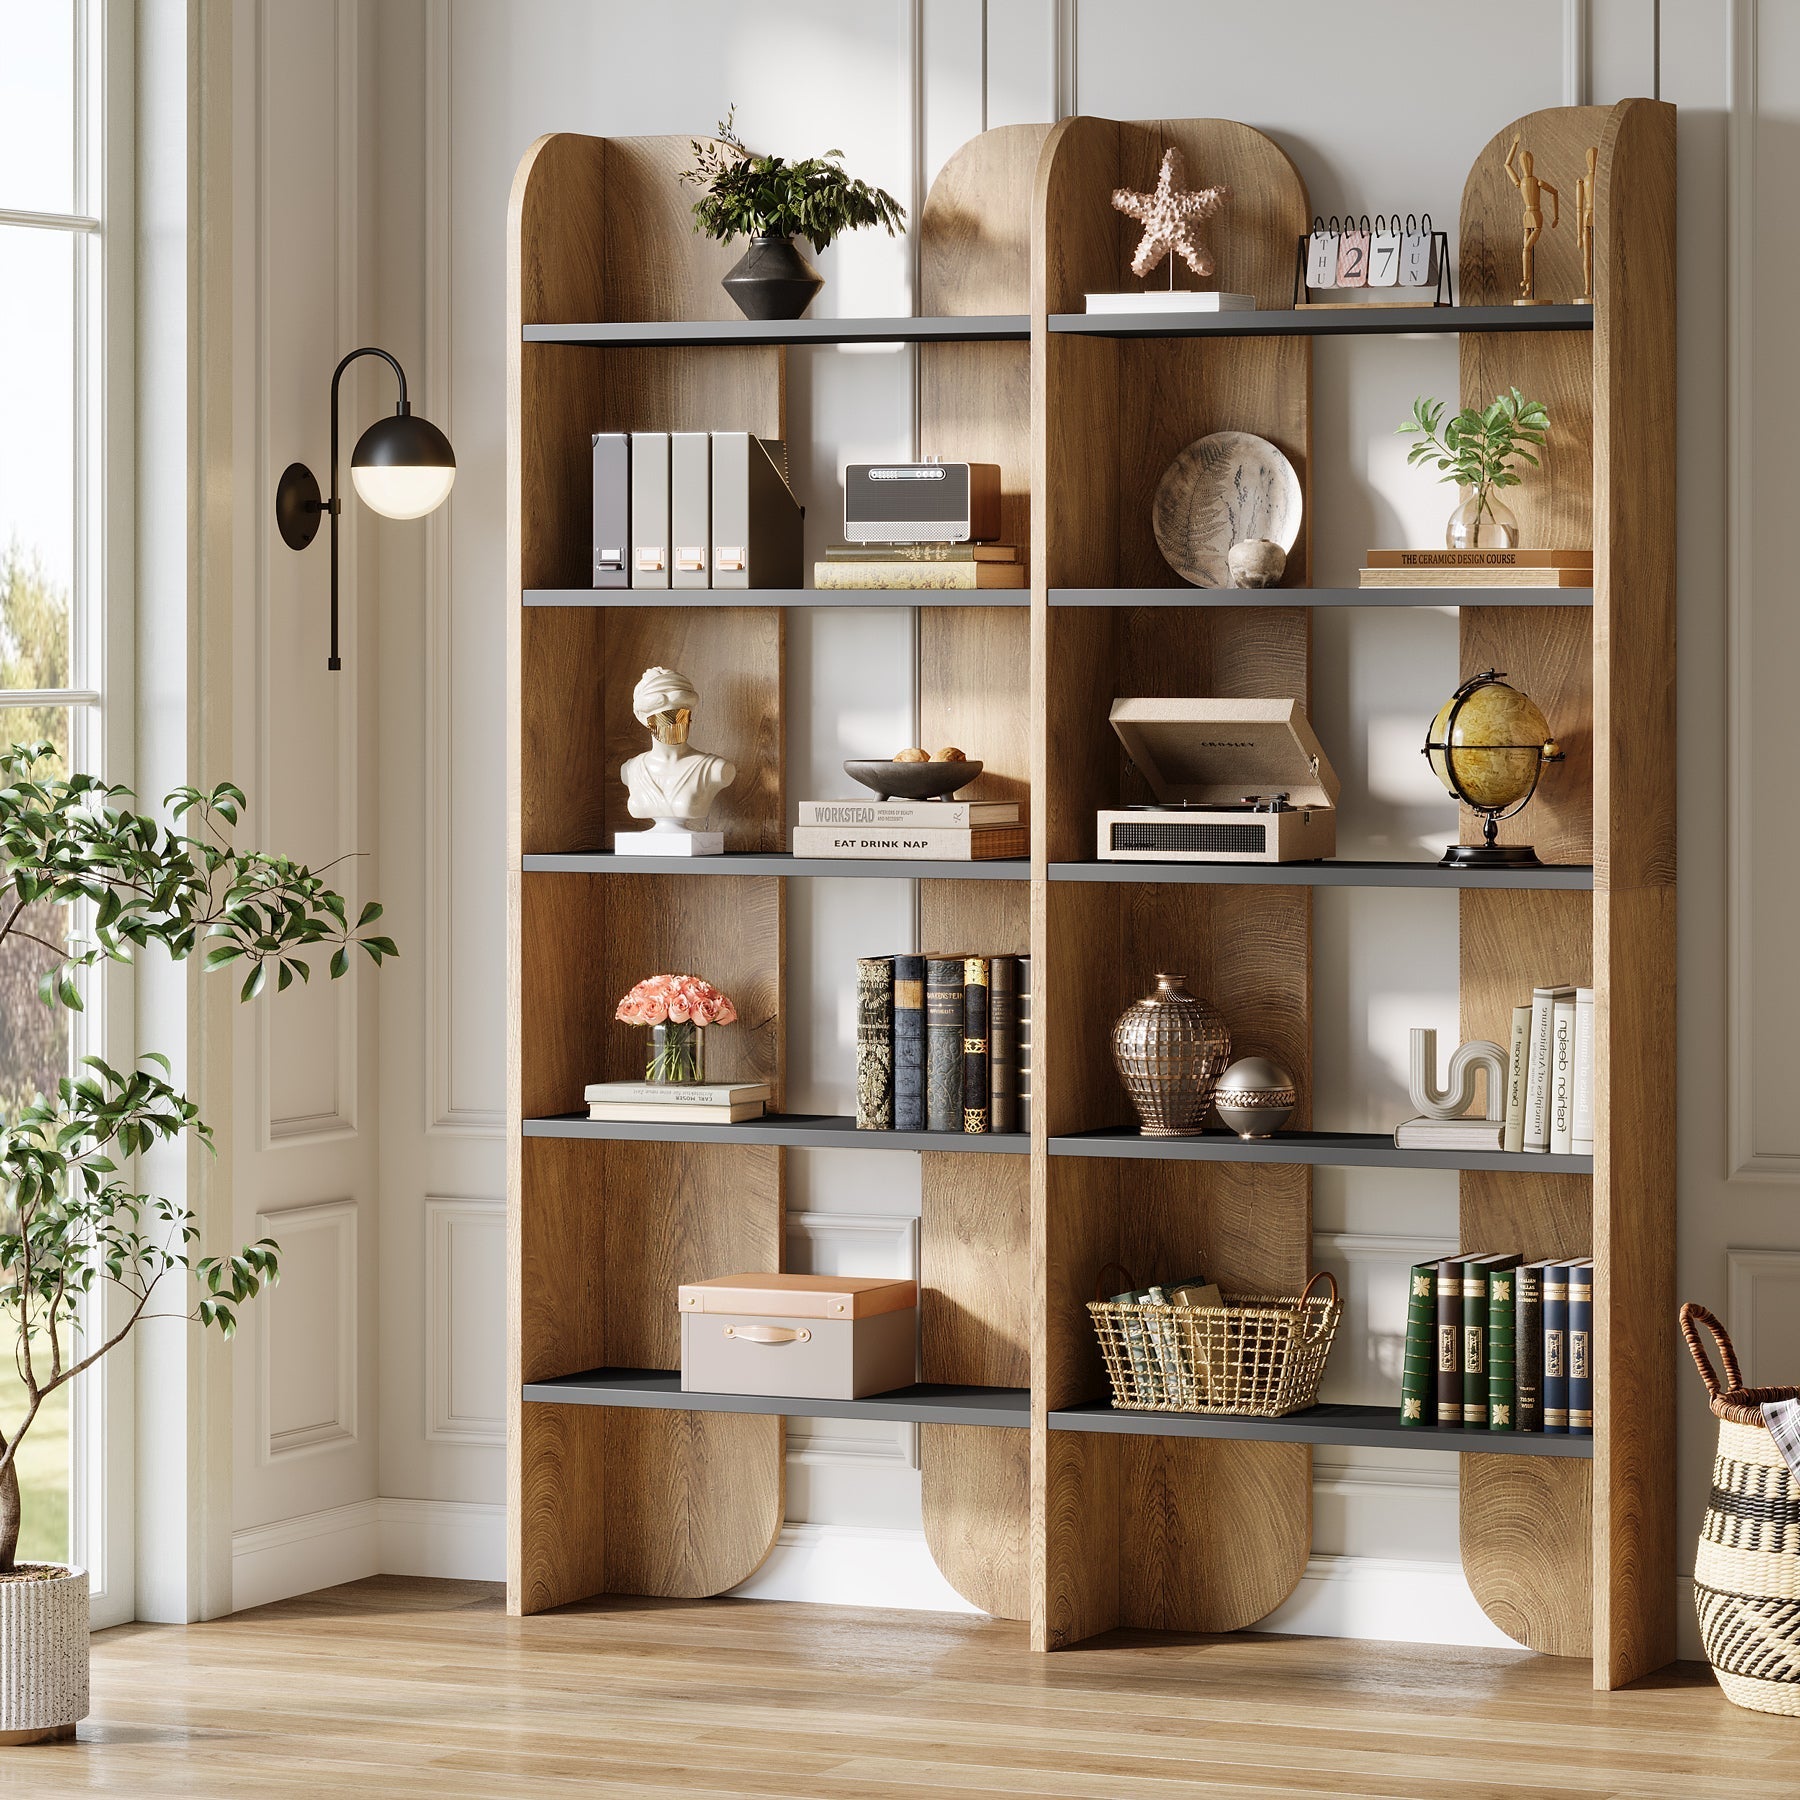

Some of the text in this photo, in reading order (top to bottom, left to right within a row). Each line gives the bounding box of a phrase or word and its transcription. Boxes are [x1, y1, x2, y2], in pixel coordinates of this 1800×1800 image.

[1401, 553, 1516, 565] THE CERAMICS DESIGN COURSE
[814, 806, 876, 824] WORKSTEAD
[833, 839, 929, 849] EAT DRINK NAP
